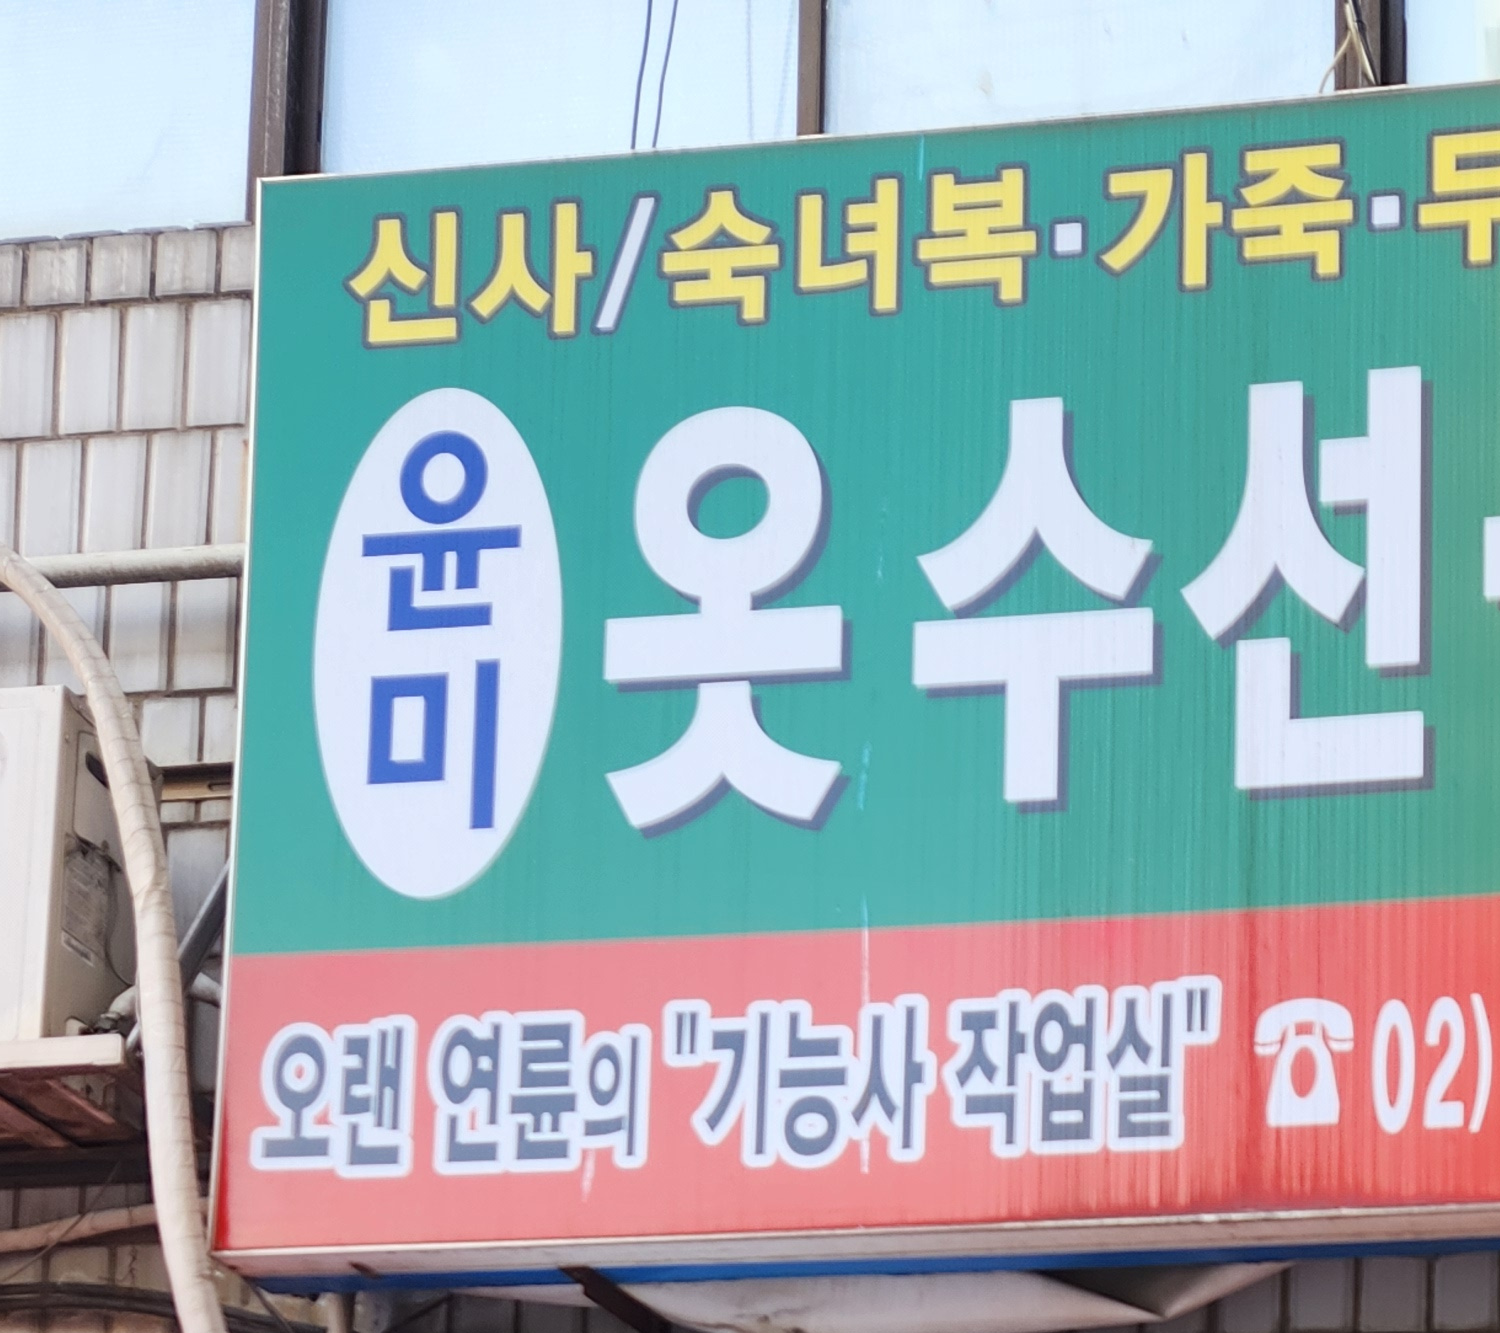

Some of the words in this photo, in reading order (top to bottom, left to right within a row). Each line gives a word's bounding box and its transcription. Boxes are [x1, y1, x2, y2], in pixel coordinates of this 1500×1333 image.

[362, 430, 522, 830] 윤미
[254, 1017, 412, 1175] 오랜
[433, 1013, 647, 1172] 연륜의
[667, 997, 926, 1166] "기능사
[947, 976, 1219, 1158] 작업실"
